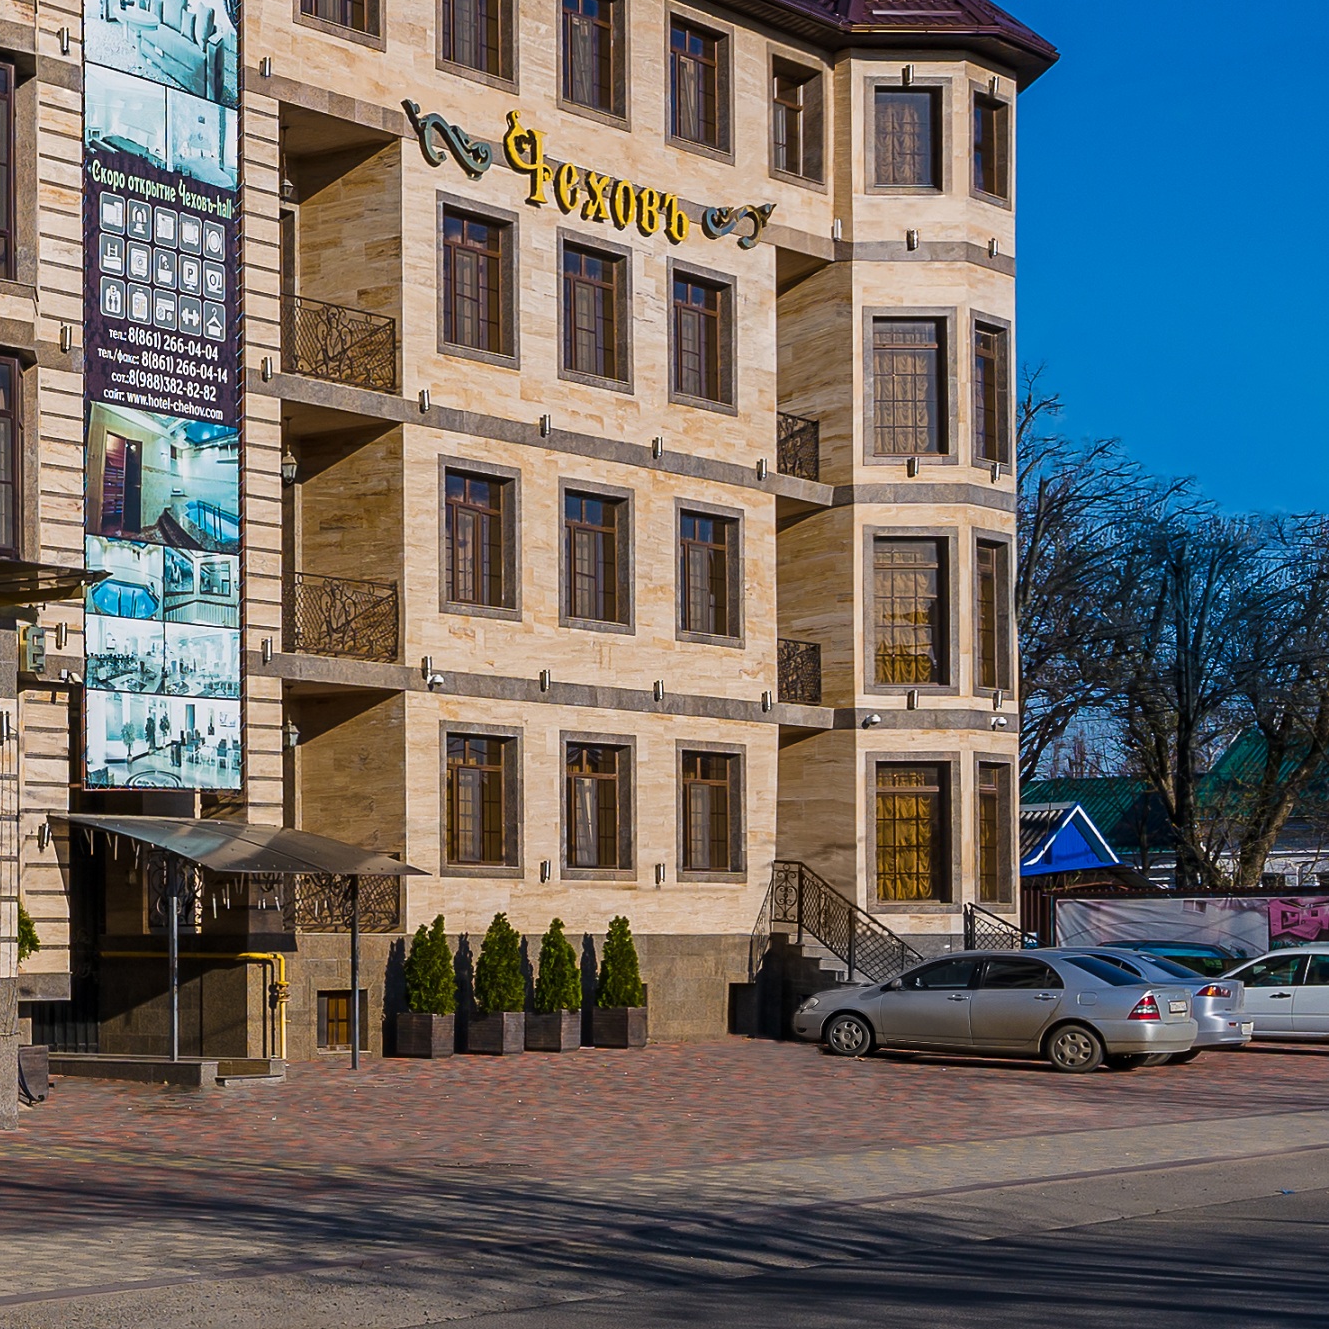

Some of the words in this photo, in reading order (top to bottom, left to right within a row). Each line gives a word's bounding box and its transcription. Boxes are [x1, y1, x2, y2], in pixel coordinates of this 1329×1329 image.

[128, 175, 176, 203] открытие
[503, 110, 690, 244] Чеховъ
[128, 327, 161, 350] 8(861)
[163, 334, 219, 361] 266-04-04
[141, 351, 174, 374] 8(861)
[176, 358, 228, 384] 266-04-14
[126, 391, 224, 420] www.hotel-chehov.com
